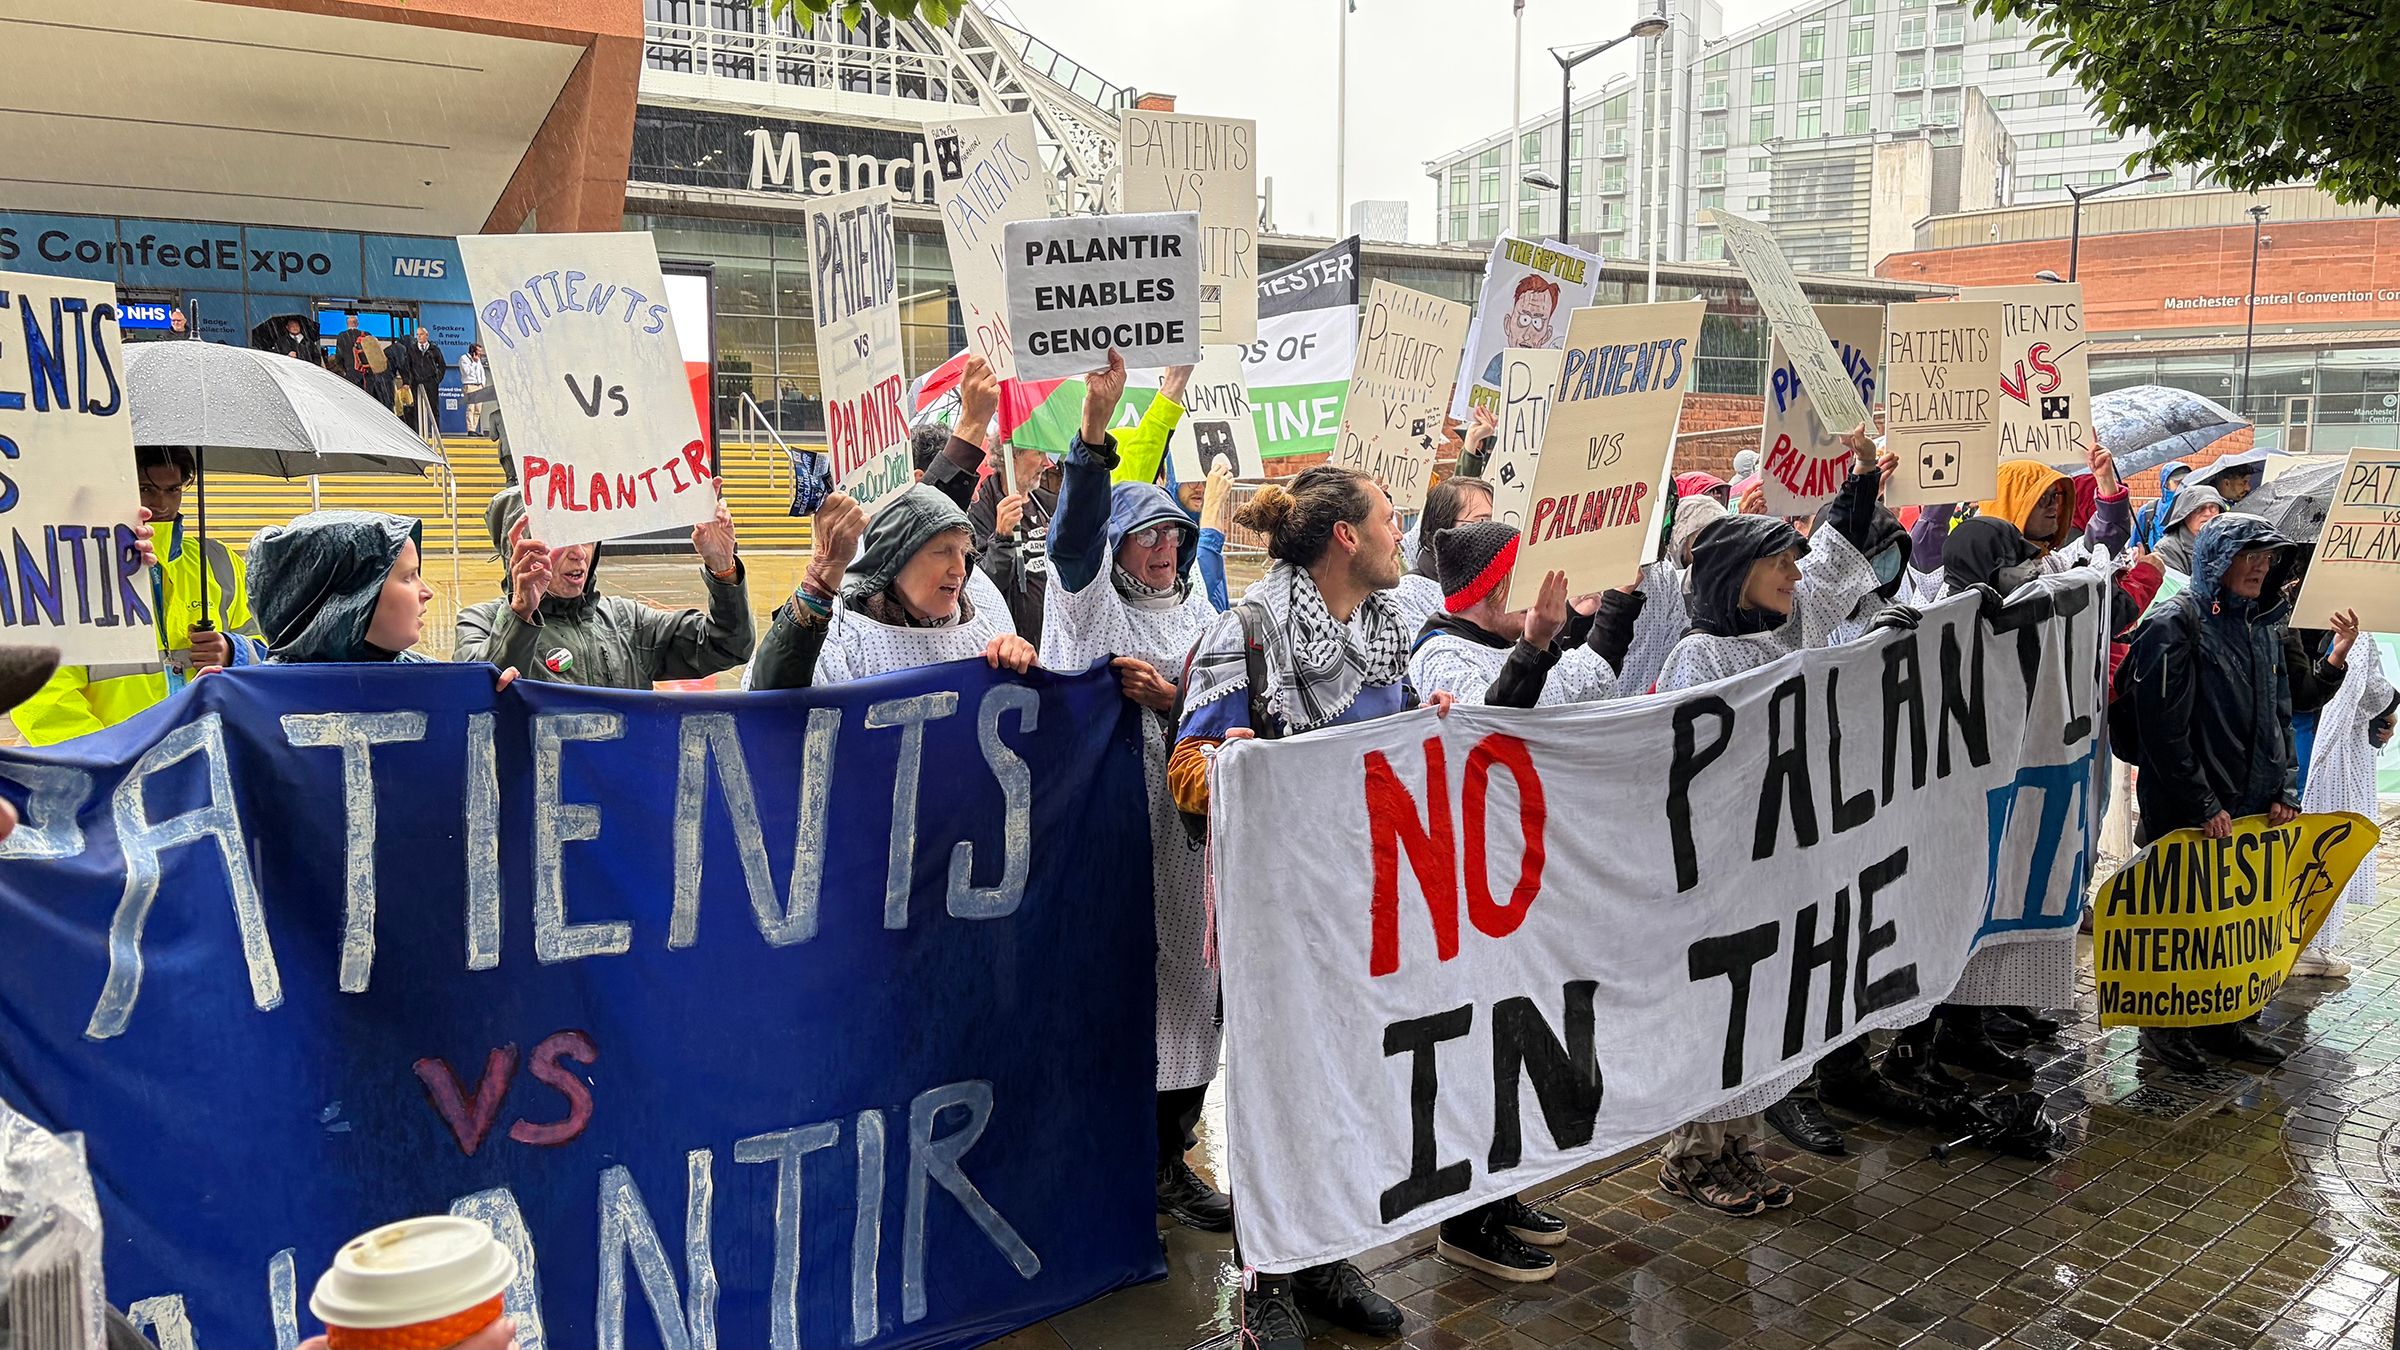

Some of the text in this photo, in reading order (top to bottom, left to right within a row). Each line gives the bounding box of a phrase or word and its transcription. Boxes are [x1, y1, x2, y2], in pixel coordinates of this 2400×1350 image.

[1130, 117, 1248, 170] PATIENTS
[751, 129, 939, 204] Manch
[946, 133, 1030, 251] PATIENTS
[1164, 173, 1204, 213] VS
[394, 257, 446, 279] NHS
[813, 202, 895, 328] PATIENTS
[1025, 234, 1183, 266] PALANTIR
[1505, 240, 1534, 267] THE
[127, 306, 166, 320] NHS
[481, 271, 667, 349] PATIENTS
[1035, 278, 1176, 312] ENABLES
[2164, 296, 2240, 310] Manchester
[2244, 292, 2293, 307] Central
[2297, 290, 2373, 304] Convention
[203, 318, 228, 326] Badge
[1027, 320, 1184, 357] GENOCIDE
[1277, 333, 1317, 362] OF
[1363, 303, 1443, 388] PATIENTS
[1889, 328, 1989, 363] PATIENTS
[1558, 338, 1687, 402] PATIENTS
[1920, 366, 1948, 390] VS
[2000, 342, 2061, 407] VS
[1382, 399, 1408, 430] VS
[1888, 389, 1990, 422] PALANTIR
[2353, 408, 2397, 417] Manchester
[2367, 415, 2396, 424] Central
[829, 374, 910, 485] PALANTIR
[1999, 421, 2089, 456] ALANTIR
[1342, 432, 1419, 490] PALANTIR
[1587, 433, 1625, 471] VS
[1763, 434, 1853, 497] PALANT
[523, 440, 711, 511] PALANTIR
[2343, 465, 2400, 503] PAT
[1528, 481, 1648, 546] PALANTIR
[2322, 525, 2400, 560] PALAN
[1363, 732, 1547, 978] NO
[1666, 580, 2105, 893] PALANTI
[2106, 826, 2302, 917] AMNESTY
[2100, 980, 2243, 1016] Manchester
[1379, 979, 1604, 1225] IN
[1687, 846, 1921, 1090] THE
[412, 1028, 598, 1156] VS
